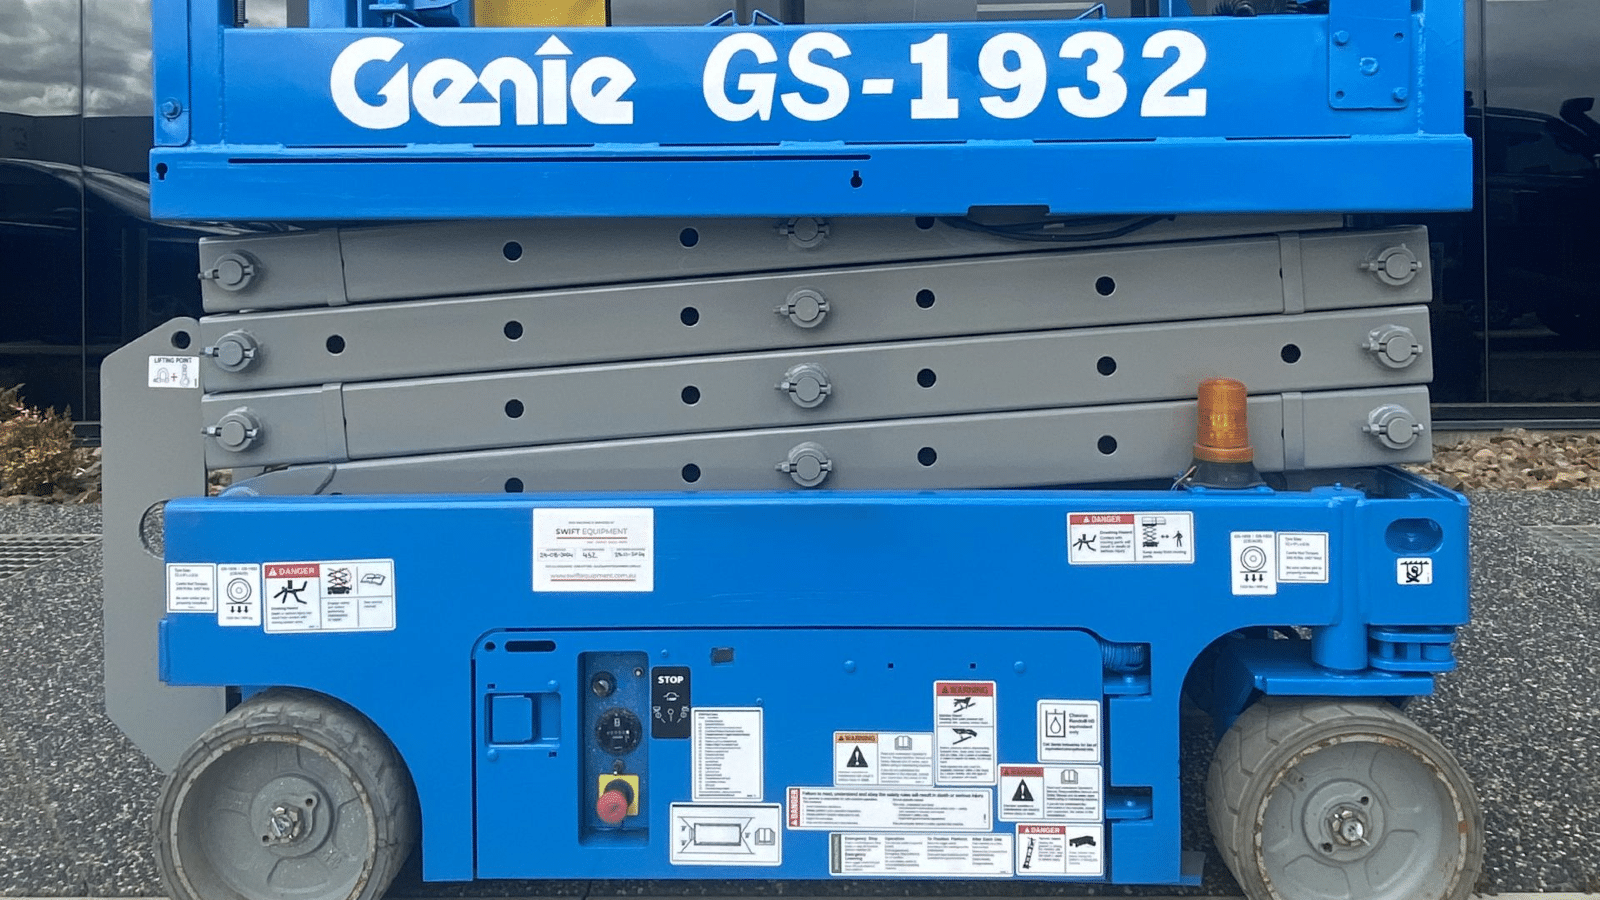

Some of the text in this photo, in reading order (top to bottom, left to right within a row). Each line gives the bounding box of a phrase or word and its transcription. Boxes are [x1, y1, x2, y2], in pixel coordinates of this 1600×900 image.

[330, 30, 1208, 129] Genie GS-1932
[1092, 516, 1122, 524] DANGER
[582, 528, 628, 536] EQUIPMENT
[279, 567, 315, 576] DANGER
[658, 675, 685, 684] STOP
[950, 686, 988, 694] WARNING
[791, 790, 799, 820] DANGER
